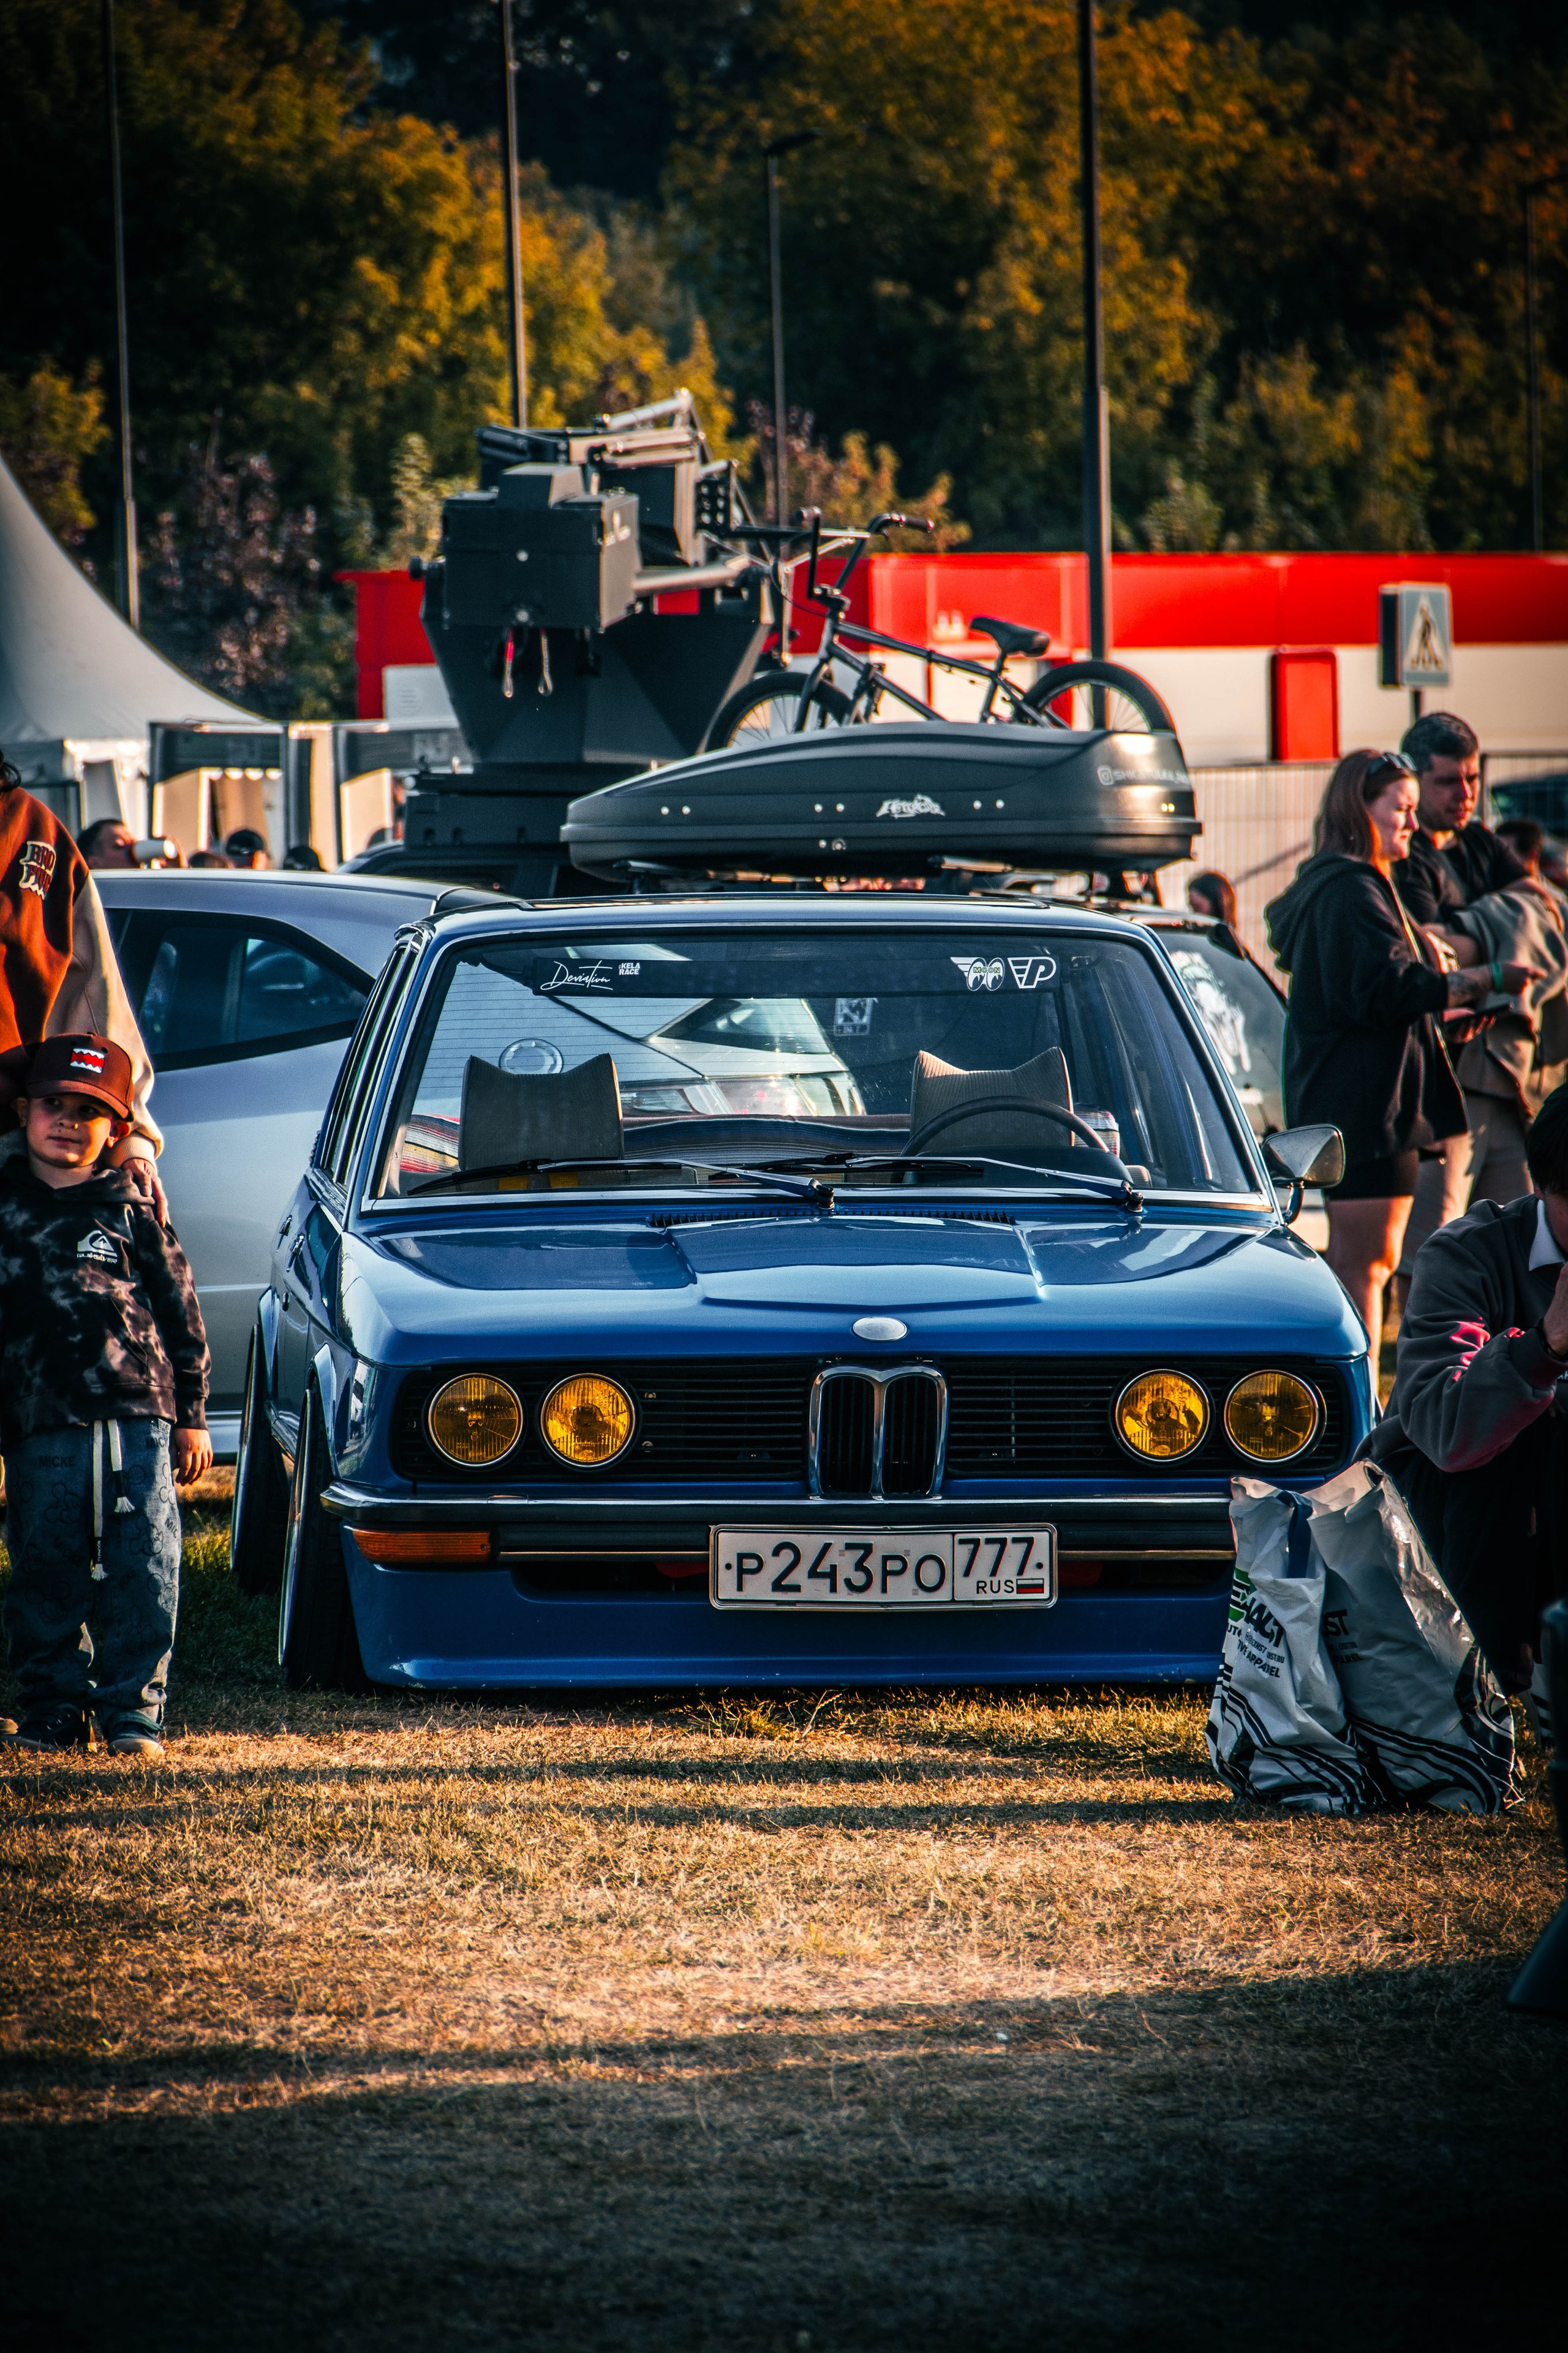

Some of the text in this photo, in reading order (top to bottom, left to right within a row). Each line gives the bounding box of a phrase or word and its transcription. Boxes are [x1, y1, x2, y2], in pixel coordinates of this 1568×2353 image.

[540, 960, 613, 990] Deviation
[39, 1456, 75, 1468] MICKE
[736, 1537, 1035, 1593] P243PO 777
[976, 1580, 1015, 1594] RUS
